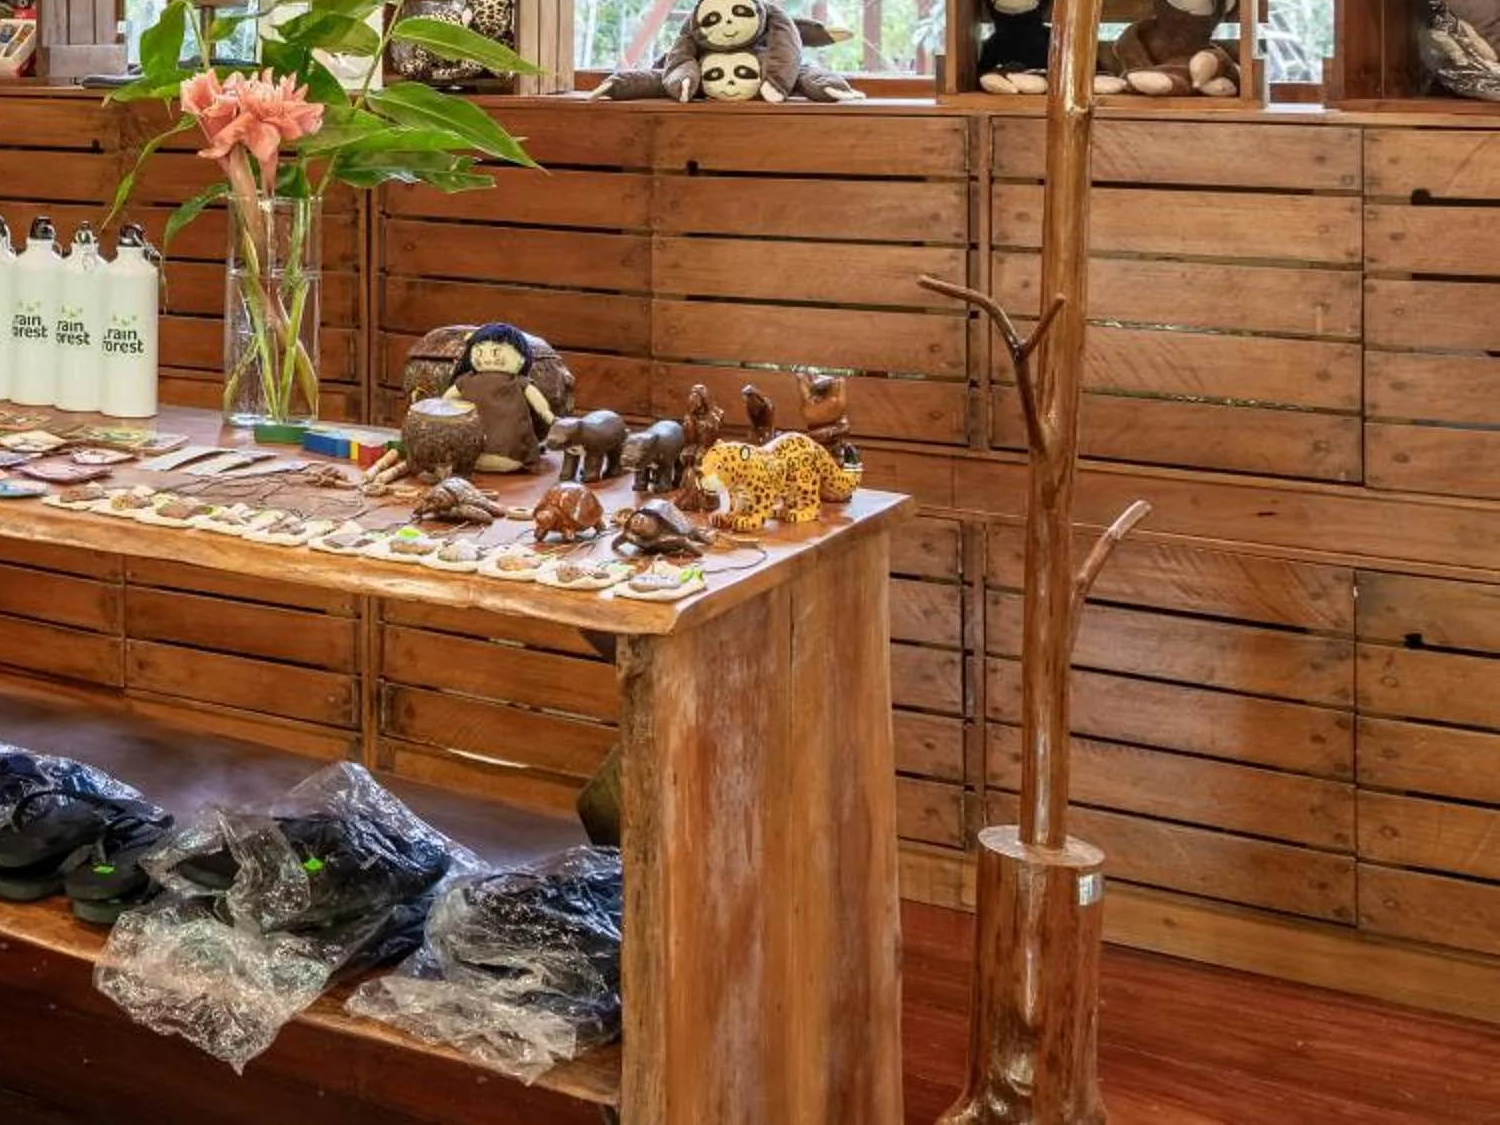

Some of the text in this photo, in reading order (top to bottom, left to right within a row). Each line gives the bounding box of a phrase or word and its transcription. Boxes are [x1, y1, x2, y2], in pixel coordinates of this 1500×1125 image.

[12, 314, 41, 325] rain
[12, 325, 48, 338] orest
[57, 320, 83, 332] rain
[56, 332, 90, 346] orest
[107, 328, 137, 340] rain
